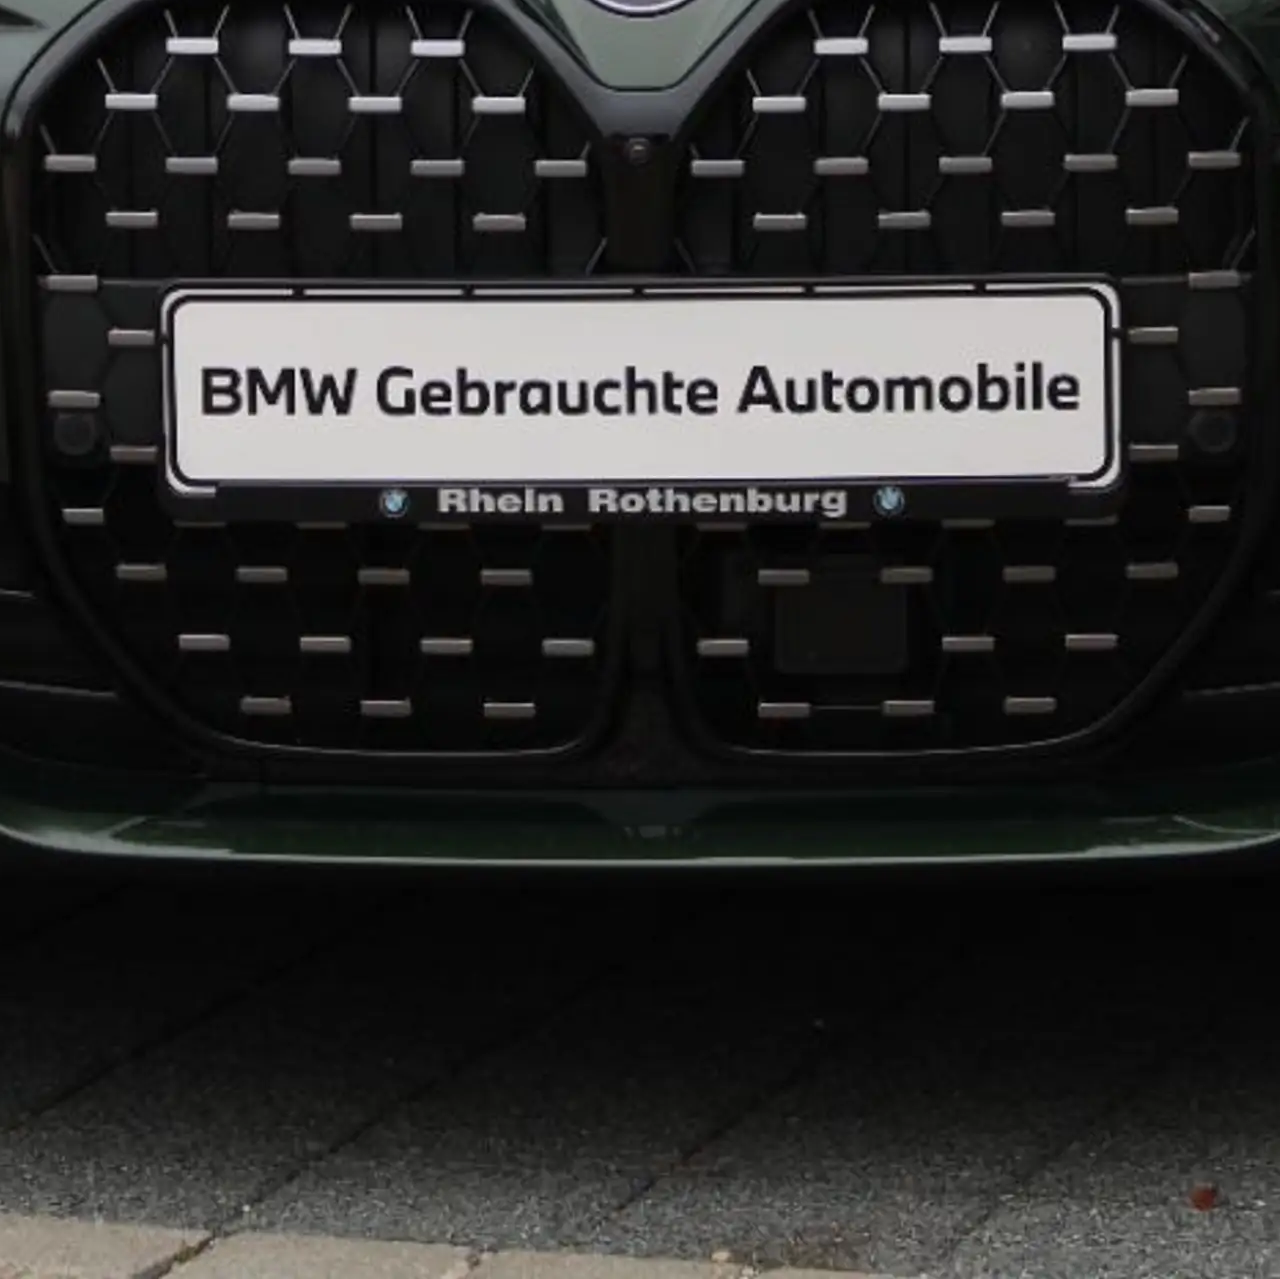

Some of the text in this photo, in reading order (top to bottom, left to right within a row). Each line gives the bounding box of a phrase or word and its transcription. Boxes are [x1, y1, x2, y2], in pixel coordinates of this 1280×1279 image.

[201, 361, 1080, 416] BMW Gebrauchte Automobile
[437, 487, 848, 518] Rhein Rothenburg
